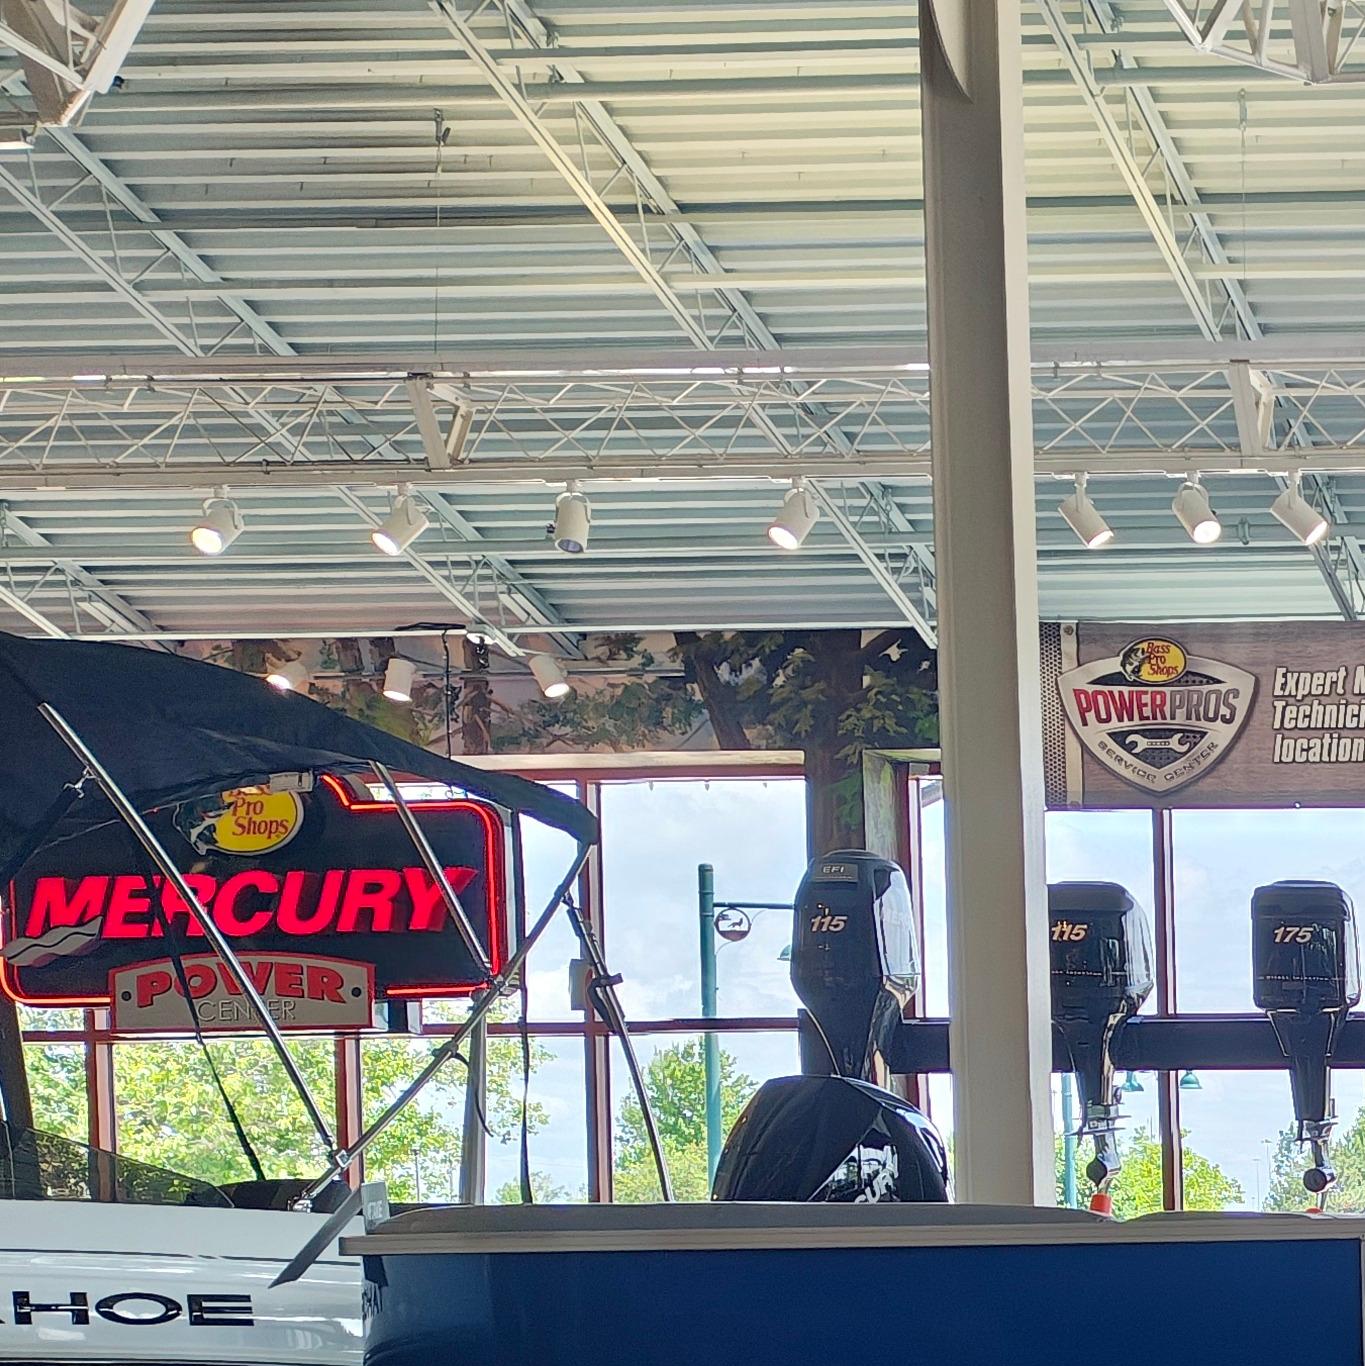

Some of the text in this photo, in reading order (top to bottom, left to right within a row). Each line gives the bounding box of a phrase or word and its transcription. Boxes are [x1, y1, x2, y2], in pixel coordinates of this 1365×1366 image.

[1146, 642, 1170, 653] Bass
[1149, 653, 1166, 664] Pro
[1148, 664, 1178, 677] Shops
[1273, 666, 1346, 700] Expert
[1073, 687, 1240, 727] POWERPROS
[1098, 740, 1219, 784] SERVICE CENTER
[232, 798, 265, 816] Pro
[232, 816, 290, 839] Shops
[26, 867, 474, 939] MERCURY
[810, 915, 848, 932] 115
[1051, 923, 1088, 941] 115
[1274, 926, 1314, 943] 175
[136, 961, 347, 1008] POWER
[197, 999, 297, 1023] CENER
[0, 1290, 255, 1327] HOE
